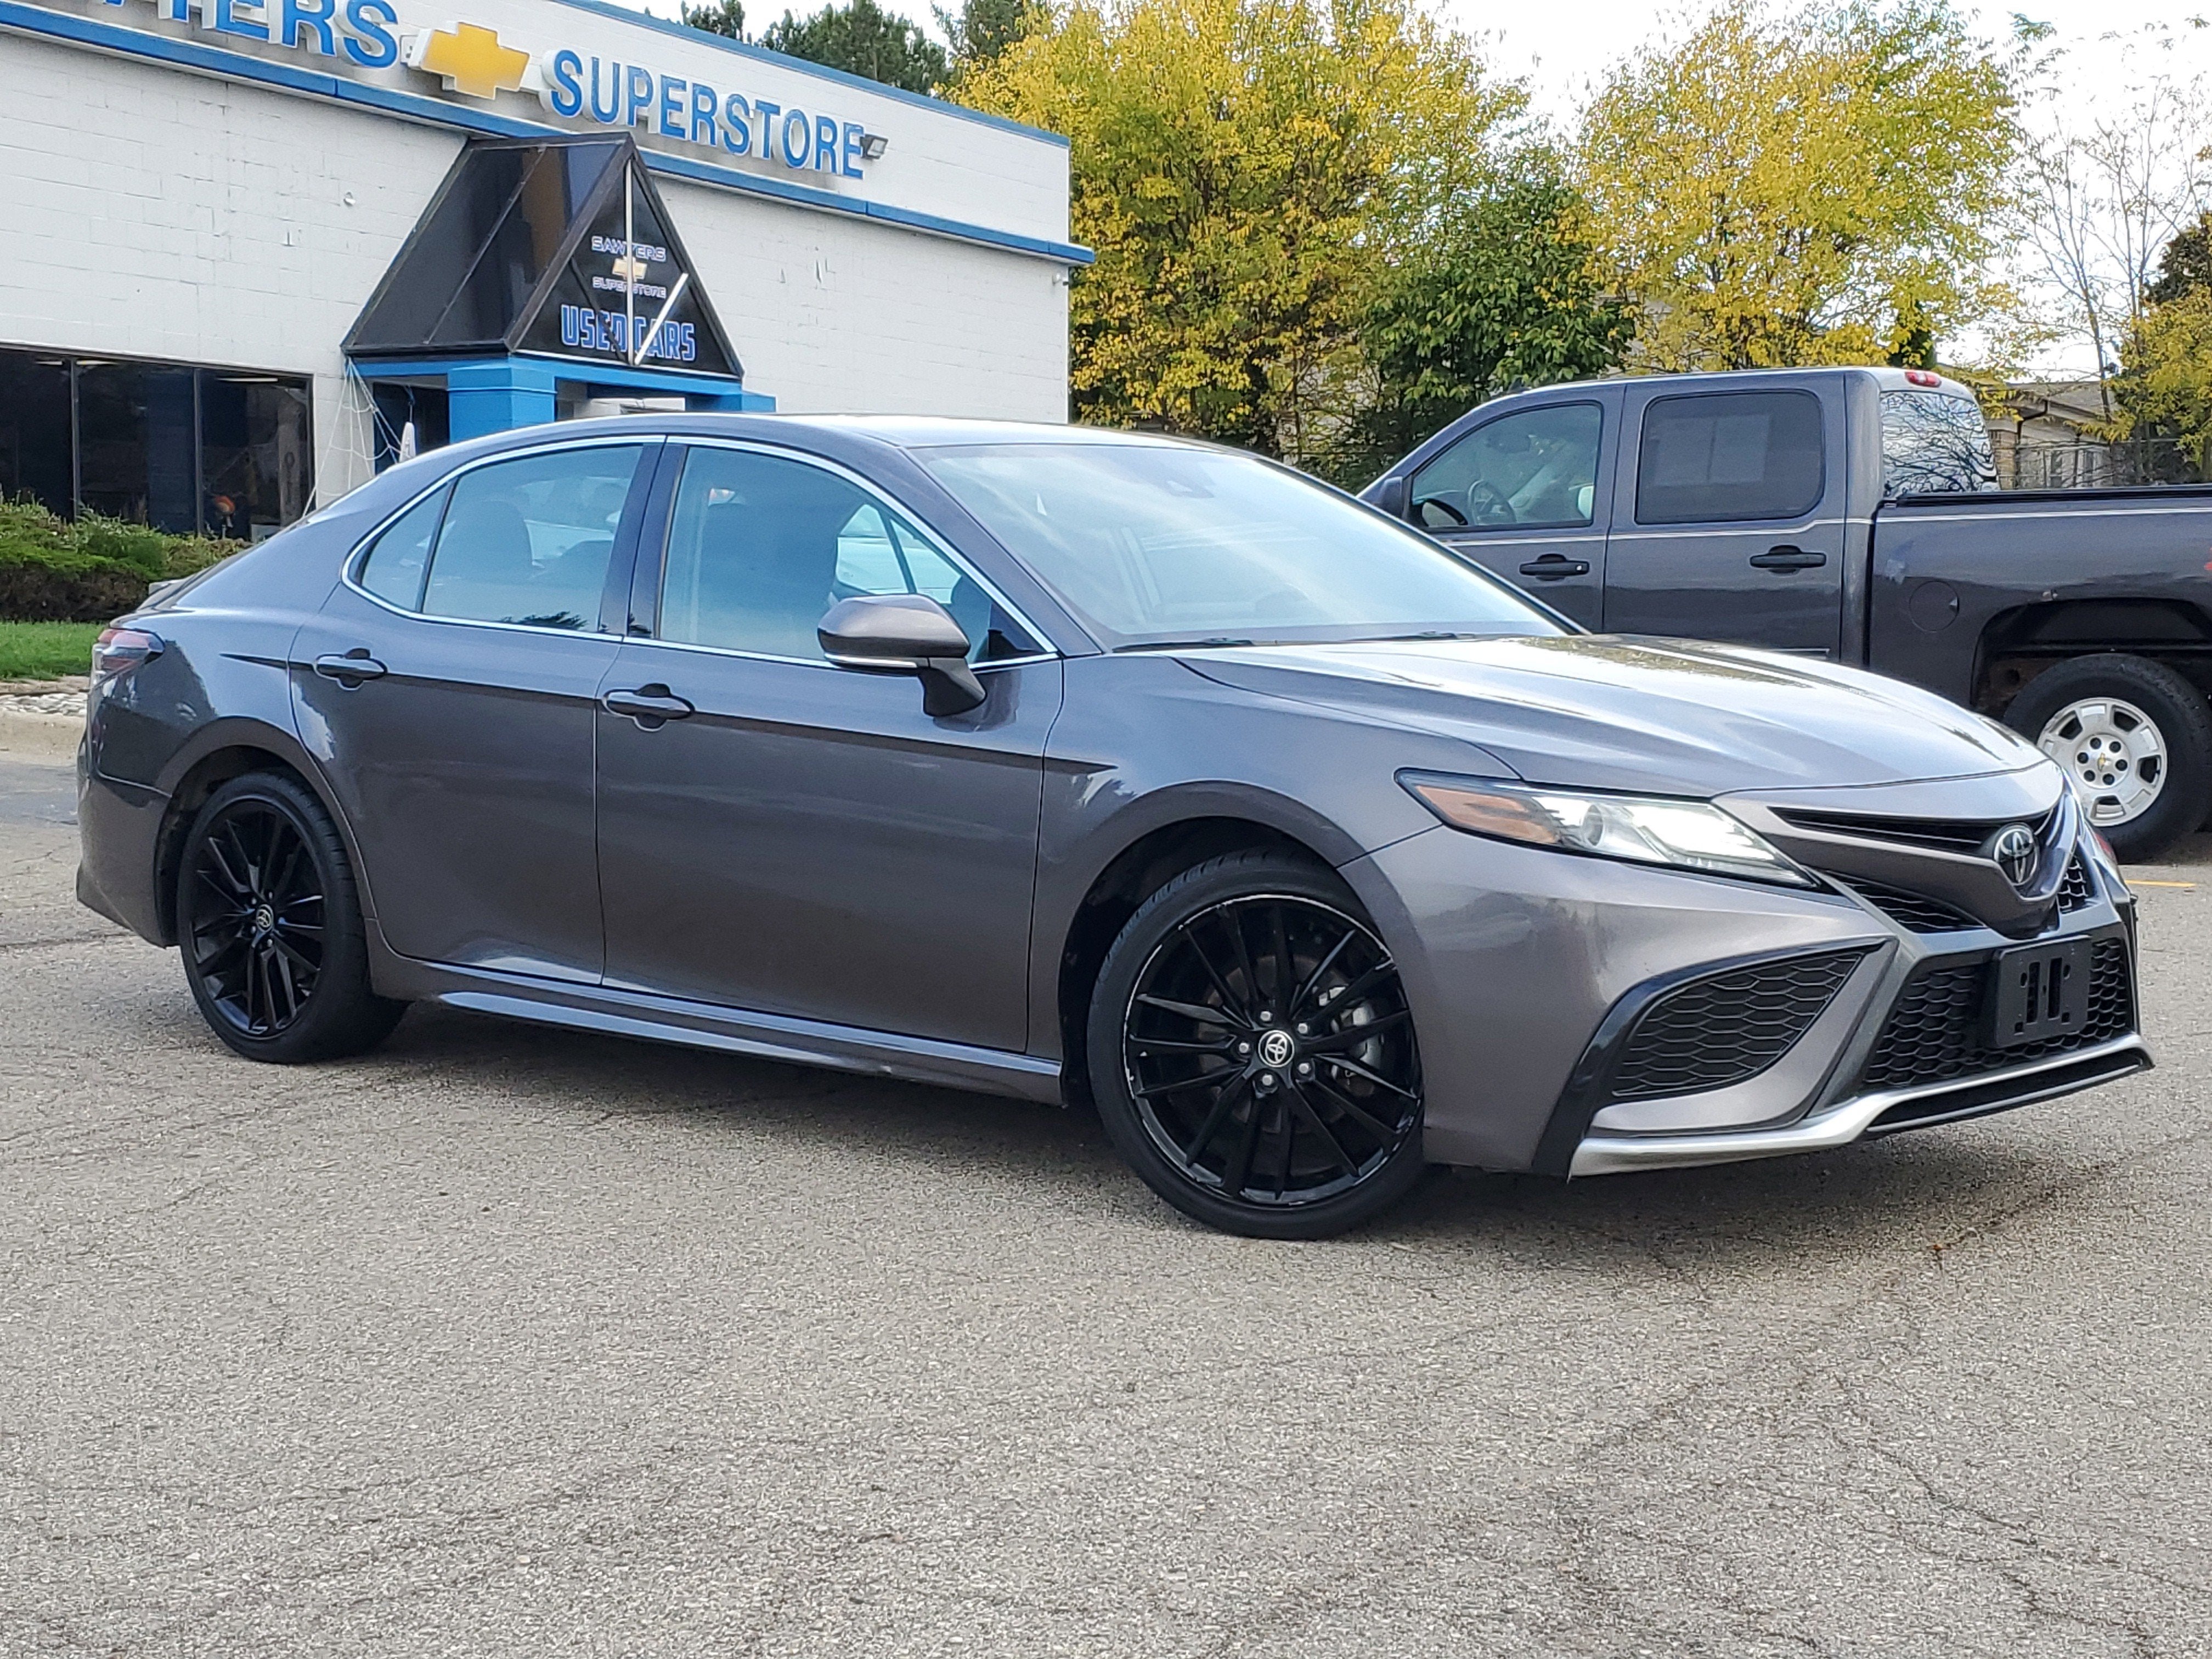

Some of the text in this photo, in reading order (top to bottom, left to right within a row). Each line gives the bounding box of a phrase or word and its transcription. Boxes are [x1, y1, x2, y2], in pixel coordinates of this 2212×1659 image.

[104, 0, 398, 68] ERS
[550, 48, 864, 180] SUPERSTORE
[561, 304, 696, 362] USED CARS
